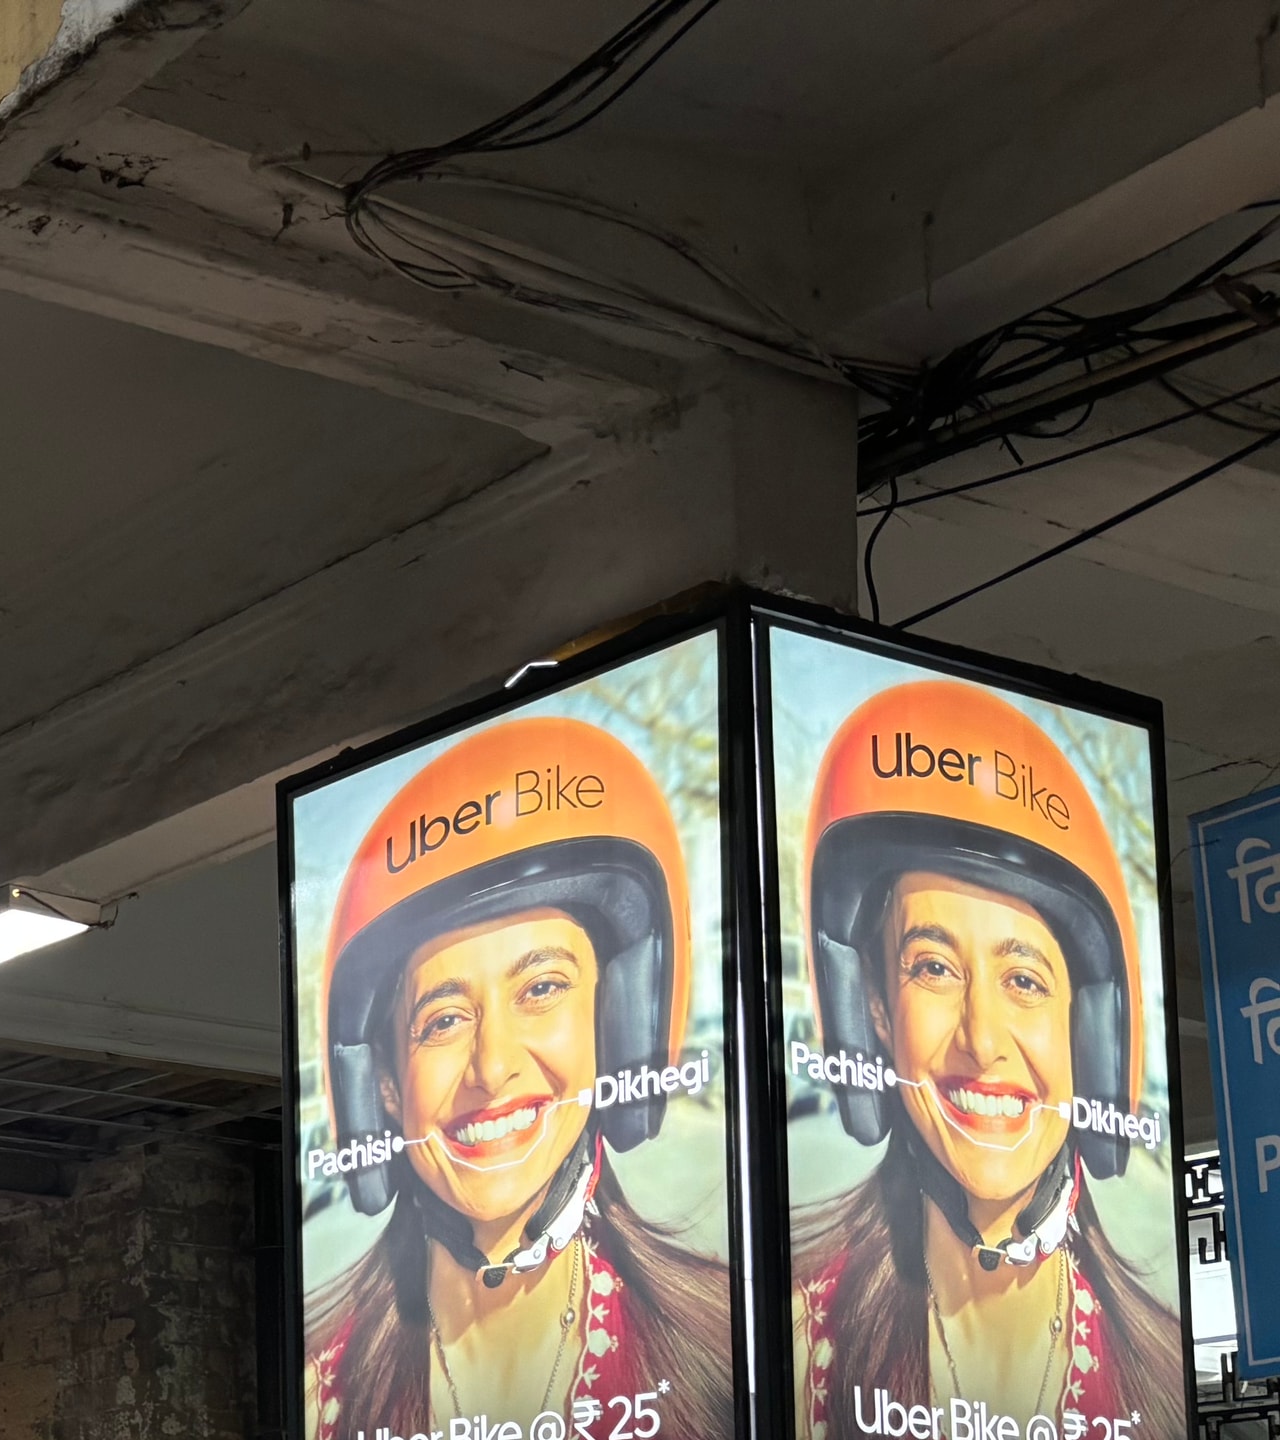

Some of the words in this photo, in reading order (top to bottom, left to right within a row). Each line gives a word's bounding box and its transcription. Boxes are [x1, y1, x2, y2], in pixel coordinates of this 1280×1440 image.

[871, 732, 982, 786] Uber
[993, 749, 1071, 831] Bike
[386, 789, 501, 874] Uber
[513, 764, 606, 818] Bike
[595, 1049, 710, 1111] Dikhegi
[791, 1040, 885, 1092] Pachisi
[1072, 1096, 1162, 1150] Dikhegi
[307, 1129, 393, 1179] Pachisi
[853, 1385, 944, 1440] Uber
